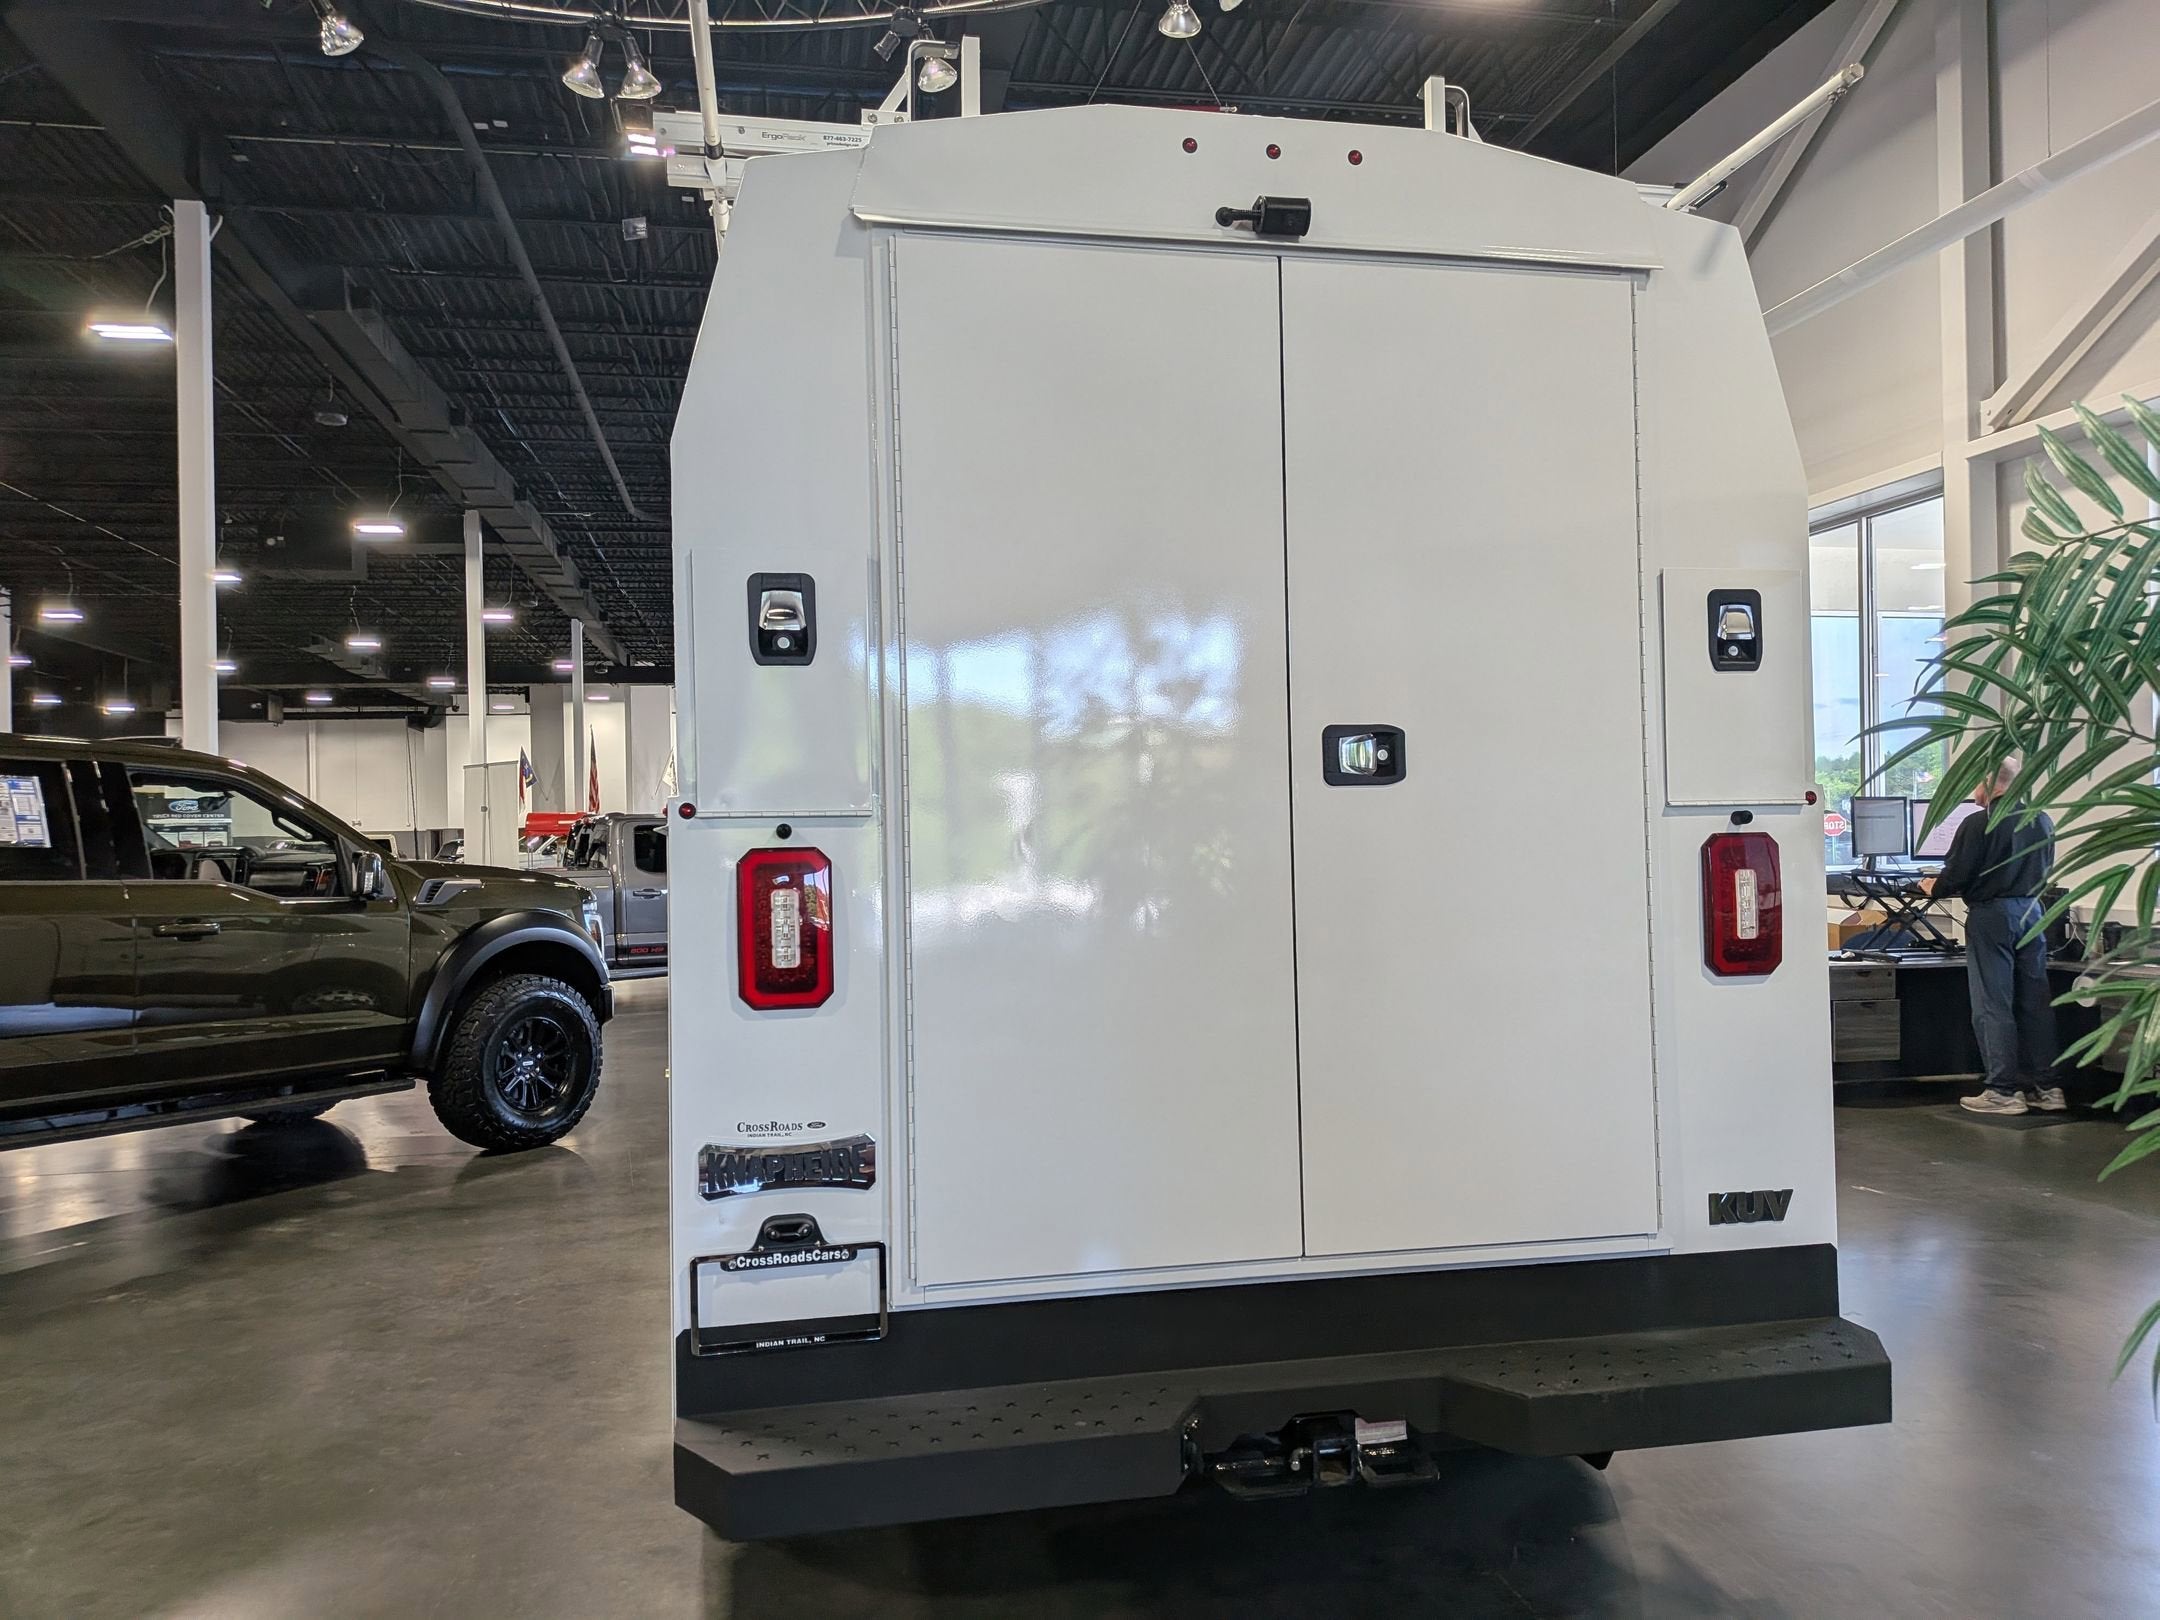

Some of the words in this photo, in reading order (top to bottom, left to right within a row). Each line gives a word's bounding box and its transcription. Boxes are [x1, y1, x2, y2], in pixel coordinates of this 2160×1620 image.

[174, 802, 199, 811] Ford
[705, 1142, 868, 1193] KNAPHEIDE
[1708, 1188, 1794, 1226] KUV
[736, 1249, 841, 1268] CrossRoadsCars
[756, 1340, 784, 1348] INDIAN
